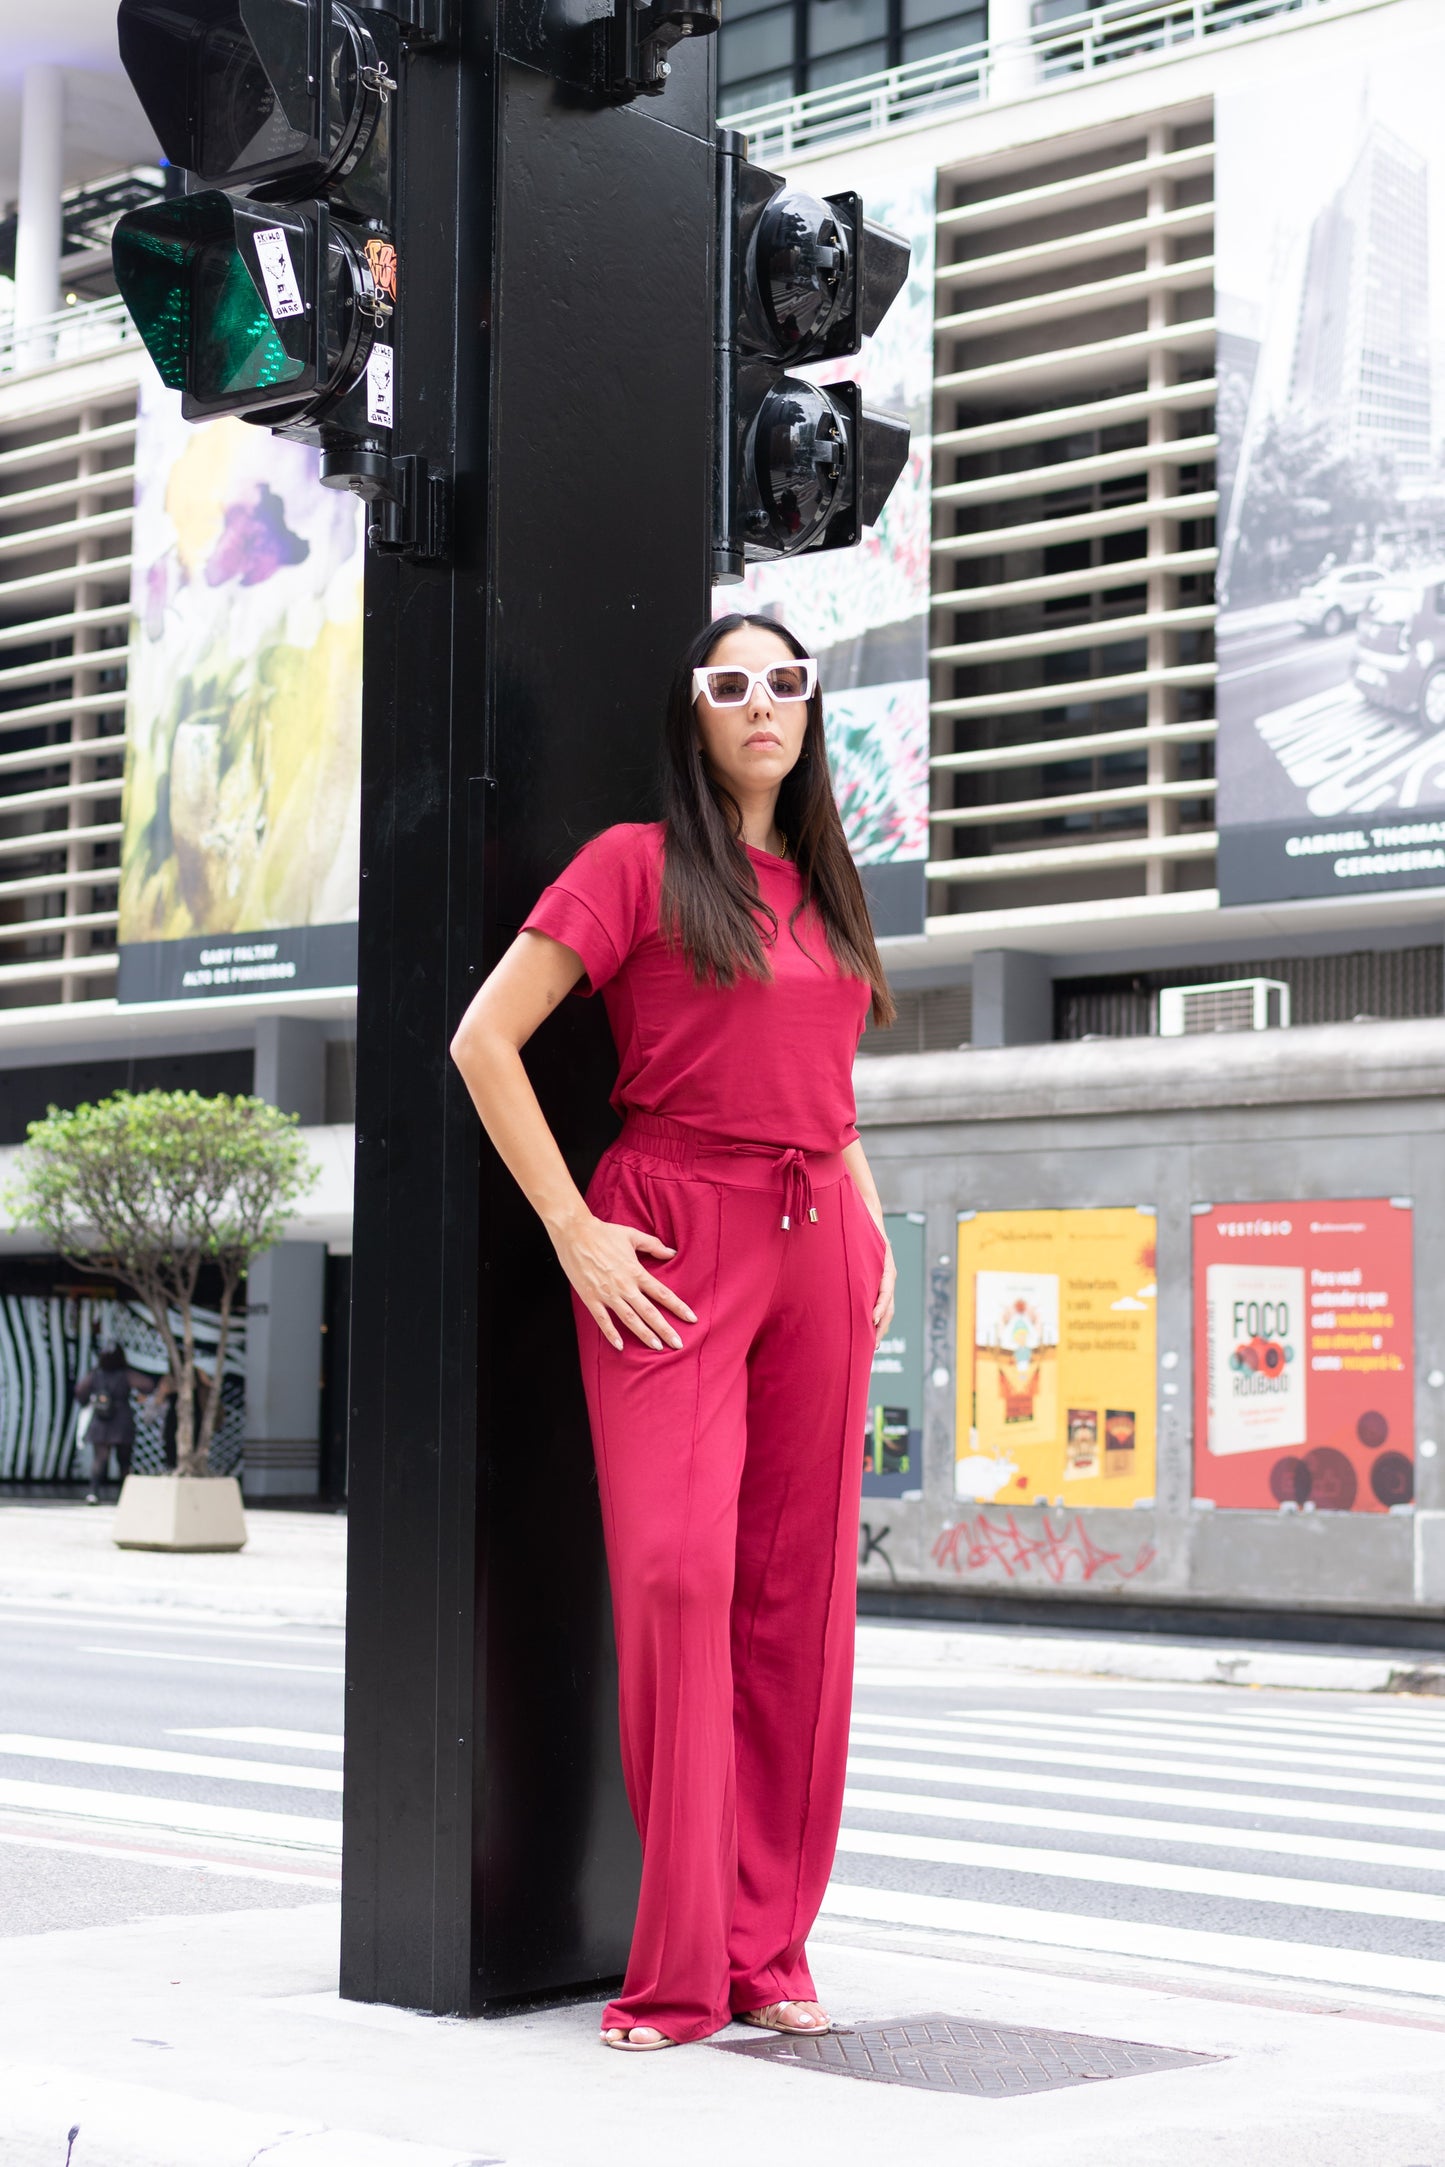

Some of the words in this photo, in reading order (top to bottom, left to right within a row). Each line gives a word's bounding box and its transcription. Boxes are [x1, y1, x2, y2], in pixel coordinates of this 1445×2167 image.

[1285, 830, 1370, 857] GABRIEL
[1334, 848, 1445, 878] CERQUEIRA
[1217, 1219, 1292, 1237] VESTÍGIO
[1232, 1300, 1290, 1339] FOCO
